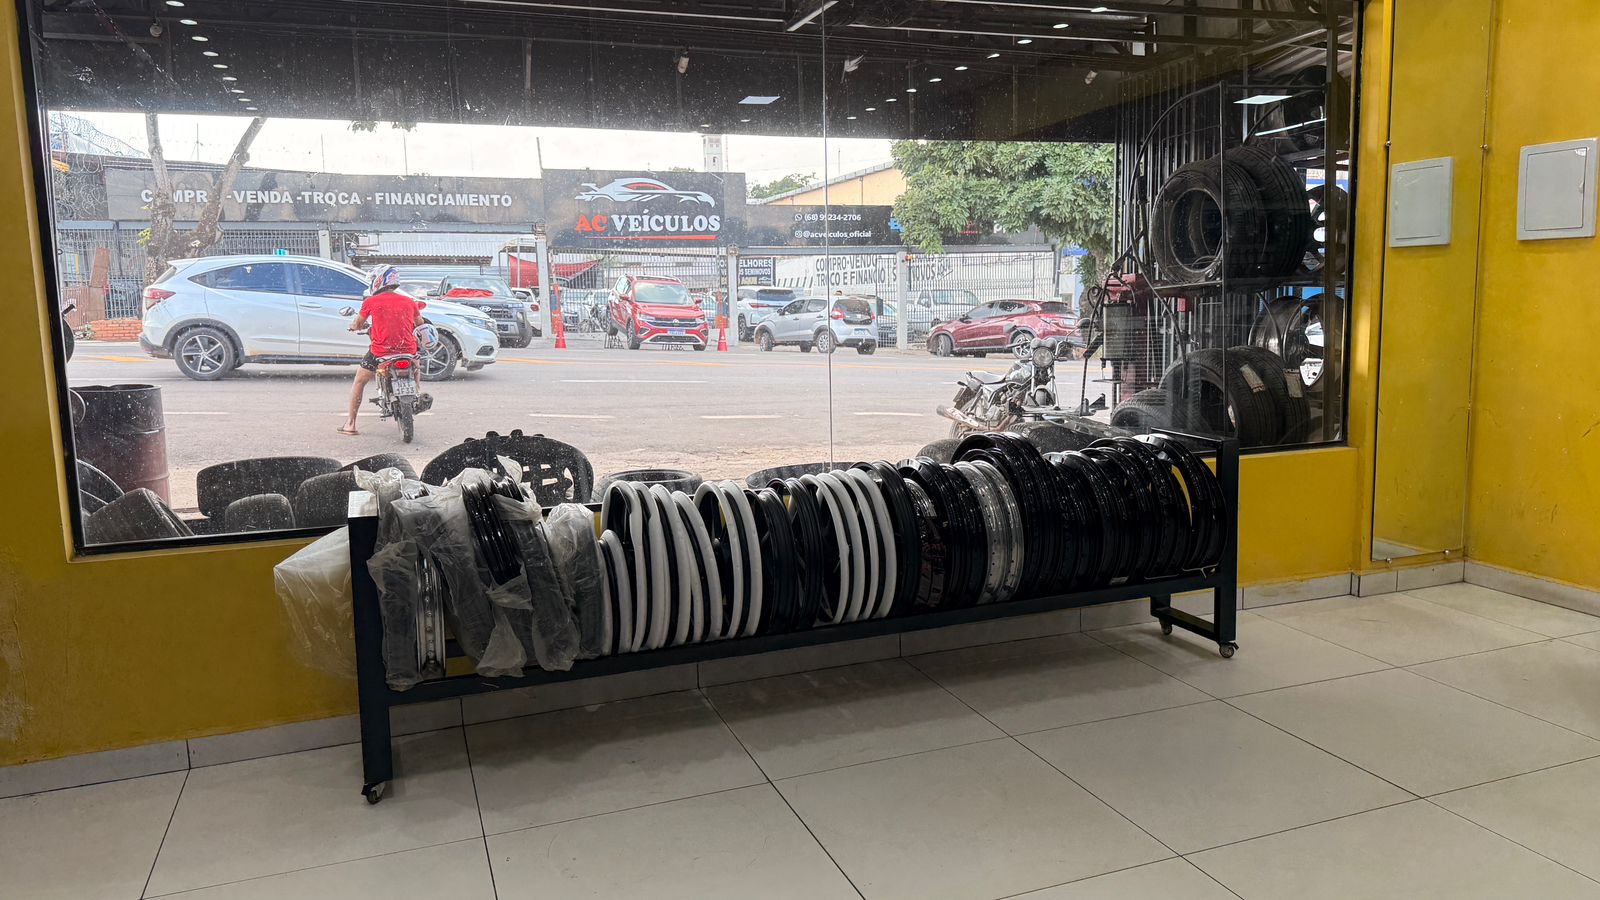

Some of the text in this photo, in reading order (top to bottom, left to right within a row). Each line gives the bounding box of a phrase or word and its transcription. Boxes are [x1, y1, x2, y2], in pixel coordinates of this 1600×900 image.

[141, 189, 219, 203] CMPR
[575, 209, 721, 233] AC VEÍCULOS
[819, 213, 861, 221] 9234-2706
